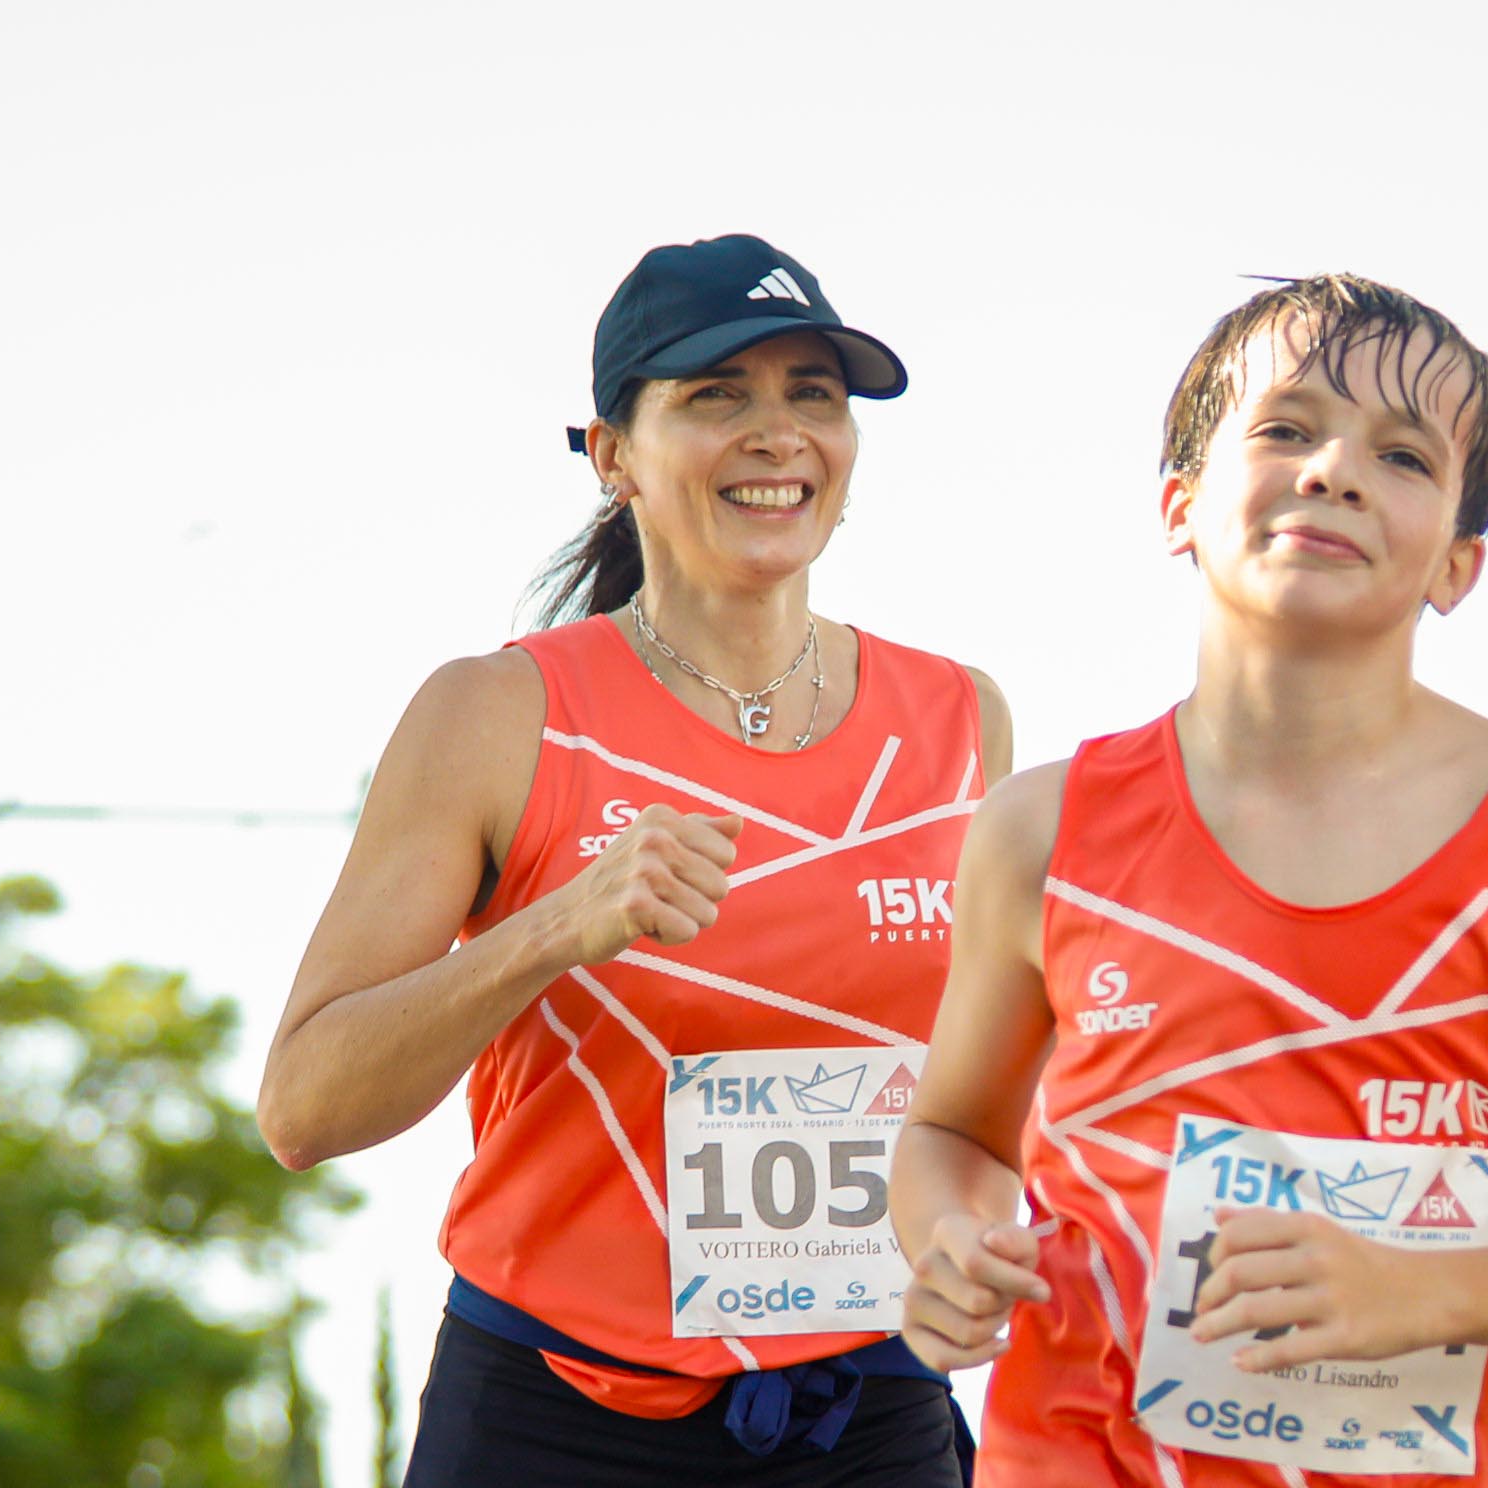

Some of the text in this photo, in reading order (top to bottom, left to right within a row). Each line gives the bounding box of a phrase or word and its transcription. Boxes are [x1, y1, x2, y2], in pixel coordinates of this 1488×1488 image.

[857, 877, 953, 926] 15K
[870, 930, 945, 943] PUERT
[697, 1075, 779, 1116] 15K
[1359, 1078, 1464, 1137] 15K
[683, 1139, 888, 1230] 105
[1211, 1154, 1461, 1221] 15K 15K
[699, 1240, 799, 1260] VOTTERO
[804, 1237, 882, 1259] Gabriela
[716, 1279, 816, 1319] osde
[1314, 1364, 1400, 1389] Lisandro
[1185, 1399, 1304, 1441] osde
